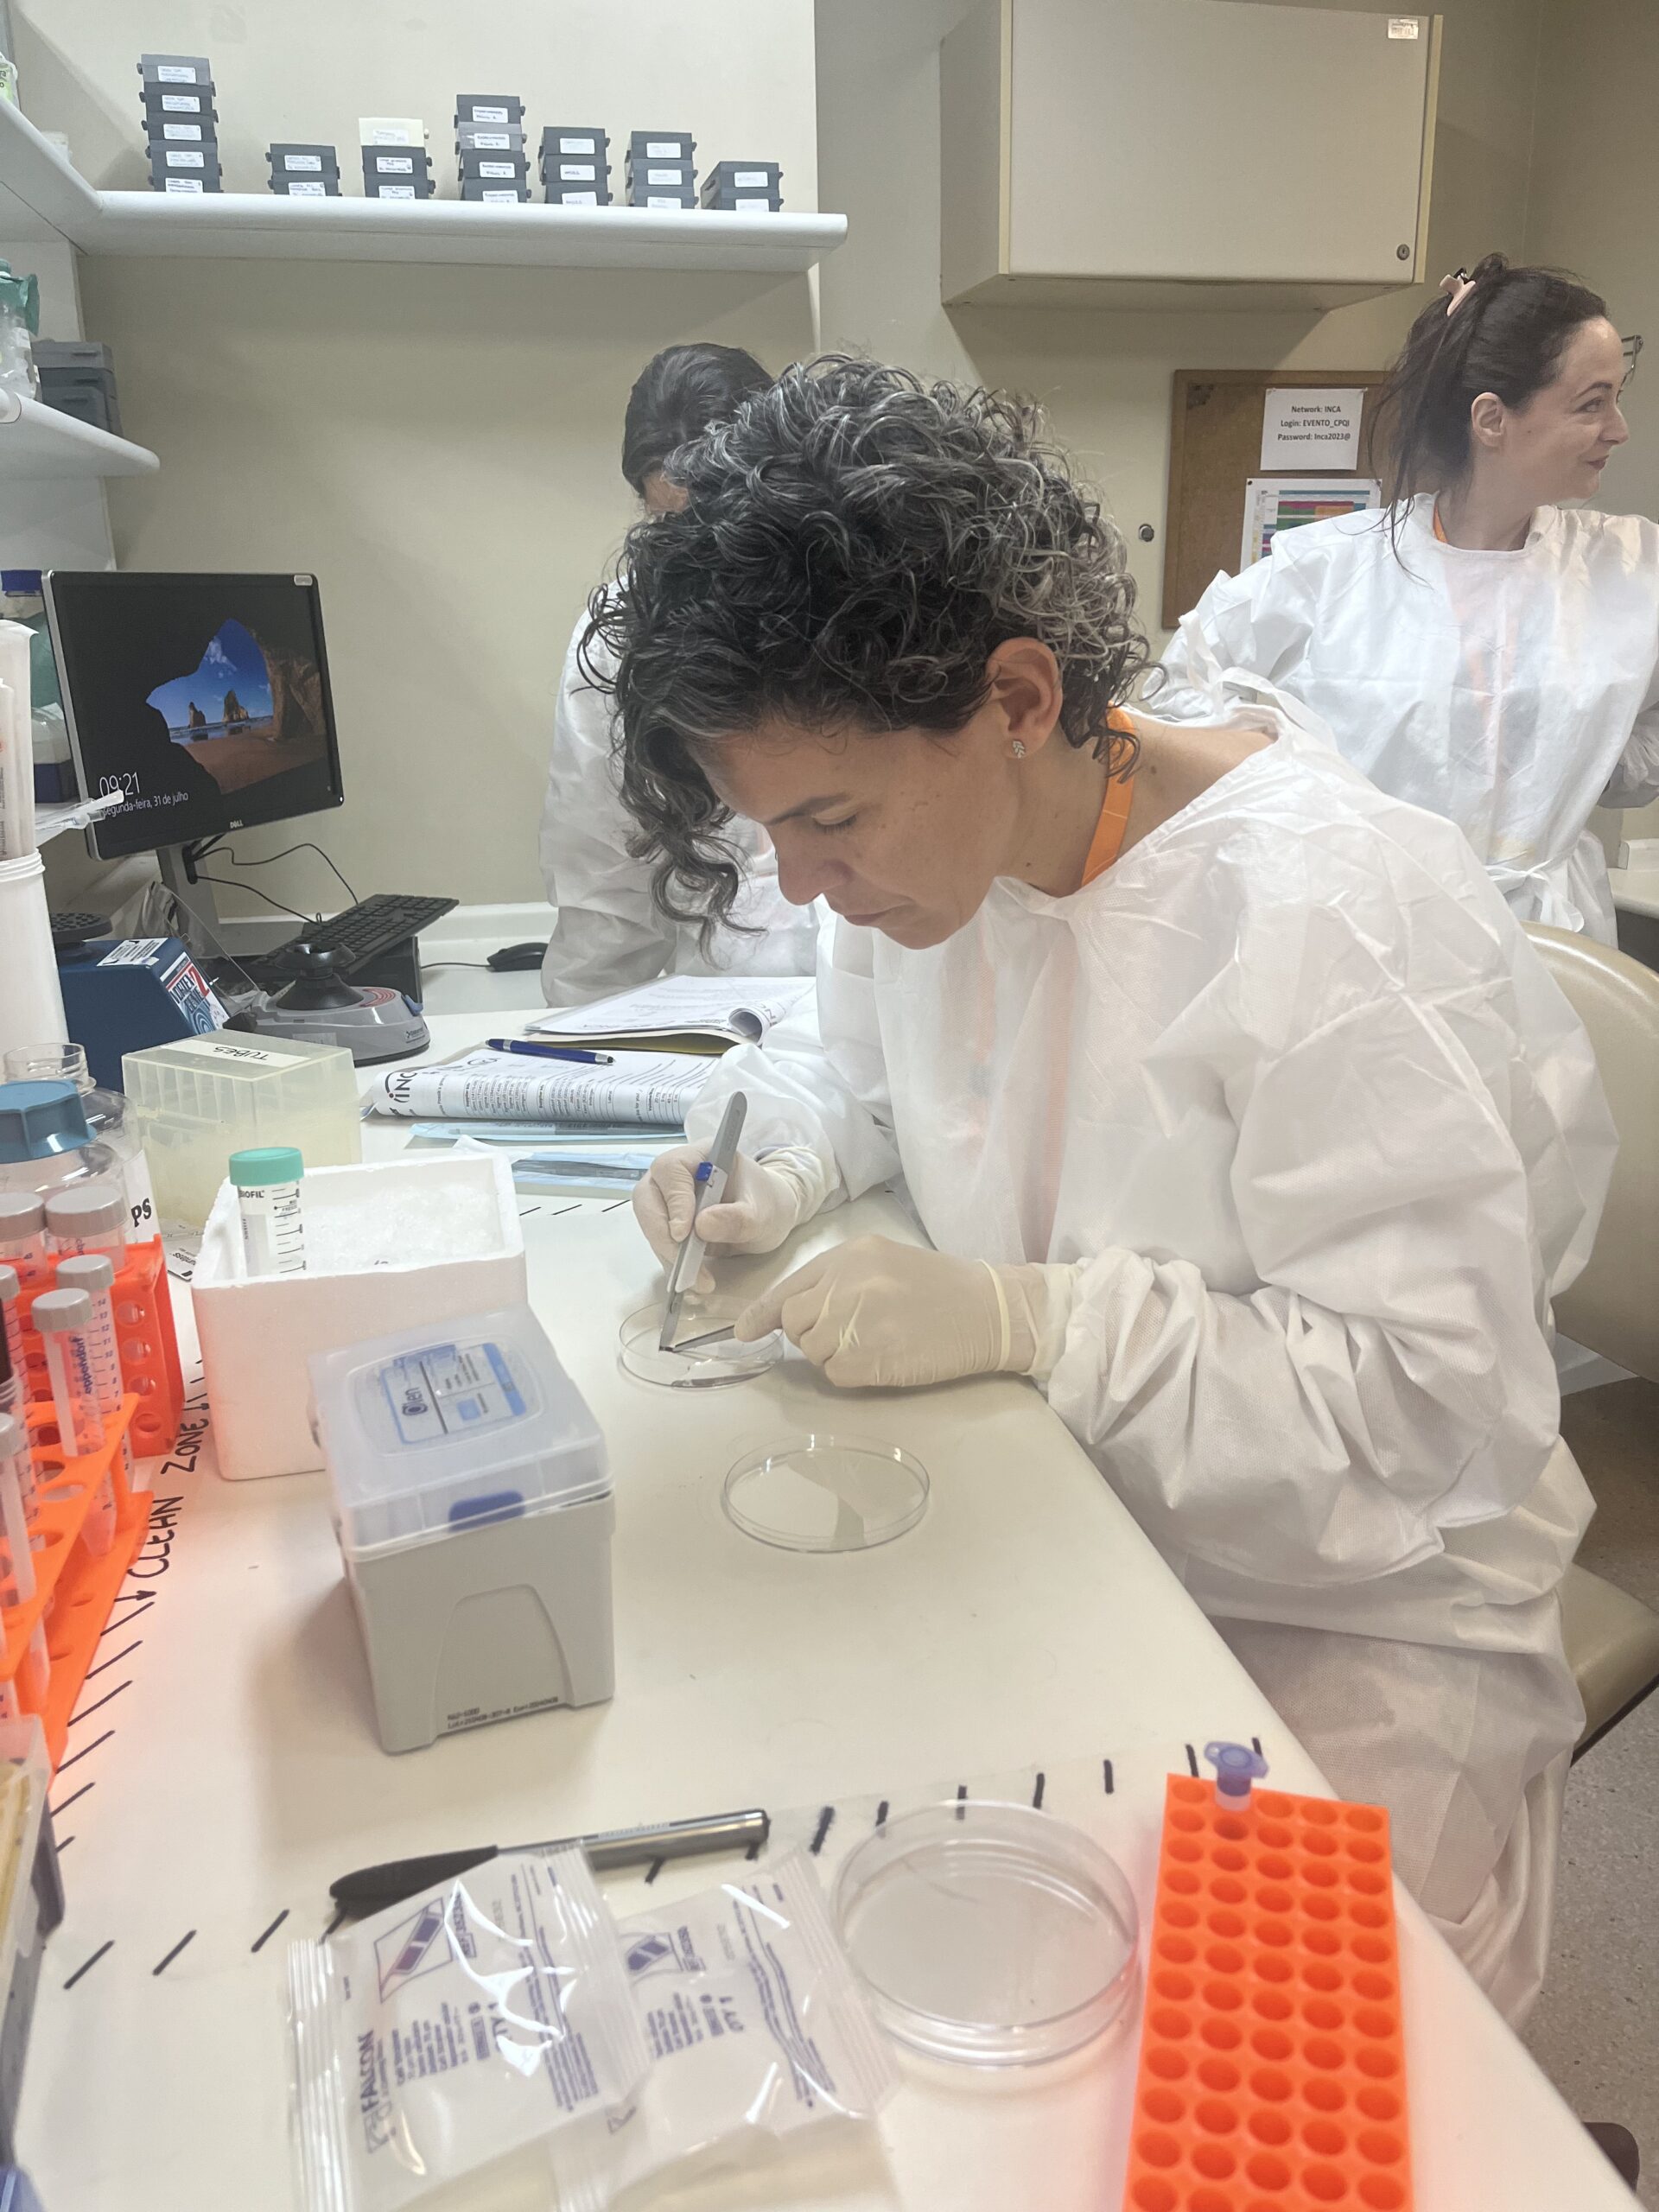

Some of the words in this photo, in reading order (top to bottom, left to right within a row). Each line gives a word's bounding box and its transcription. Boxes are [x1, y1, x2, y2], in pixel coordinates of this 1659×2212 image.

[1314, 433, 1351, 442] Inca2023@
[99, 772, 140, 798] 09:21
[154, 795, 162, 807] 31
[162, 794, 171, 805] de
[172, 791, 188, 806] julho
[213, 1046, 270, 1061] TUBES
[161, 1418, 209, 1475] ZONE
[358, 2028, 380, 2113] FALCON
